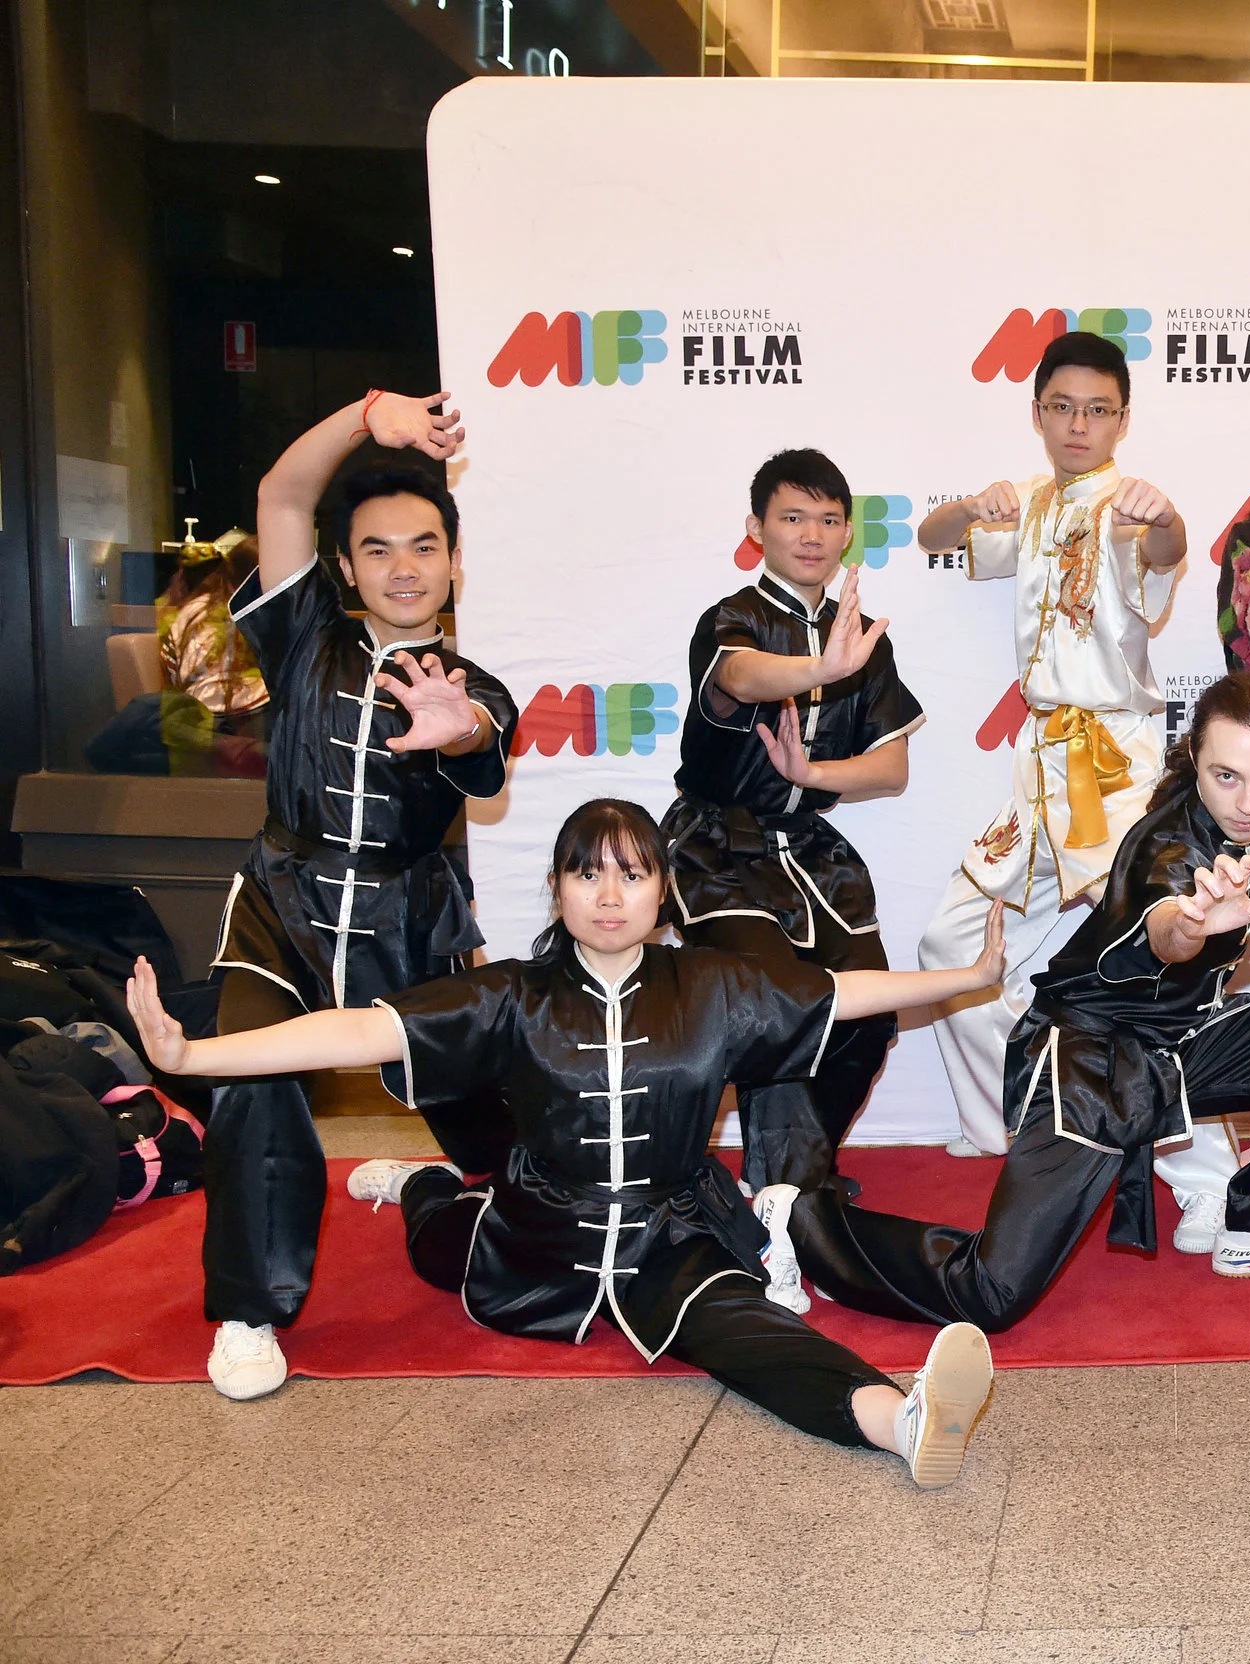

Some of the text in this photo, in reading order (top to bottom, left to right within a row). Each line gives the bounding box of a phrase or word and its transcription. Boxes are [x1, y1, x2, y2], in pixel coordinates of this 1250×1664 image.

[683, 309, 771, 320] MELBOURNE
[682, 322, 802, 333] INTERNATIONAL
[683, 335, 802, 366] FILM
[684, 369, 803, 385] FESTIVAL
[1166, 676, 1221, 686] MELBO
